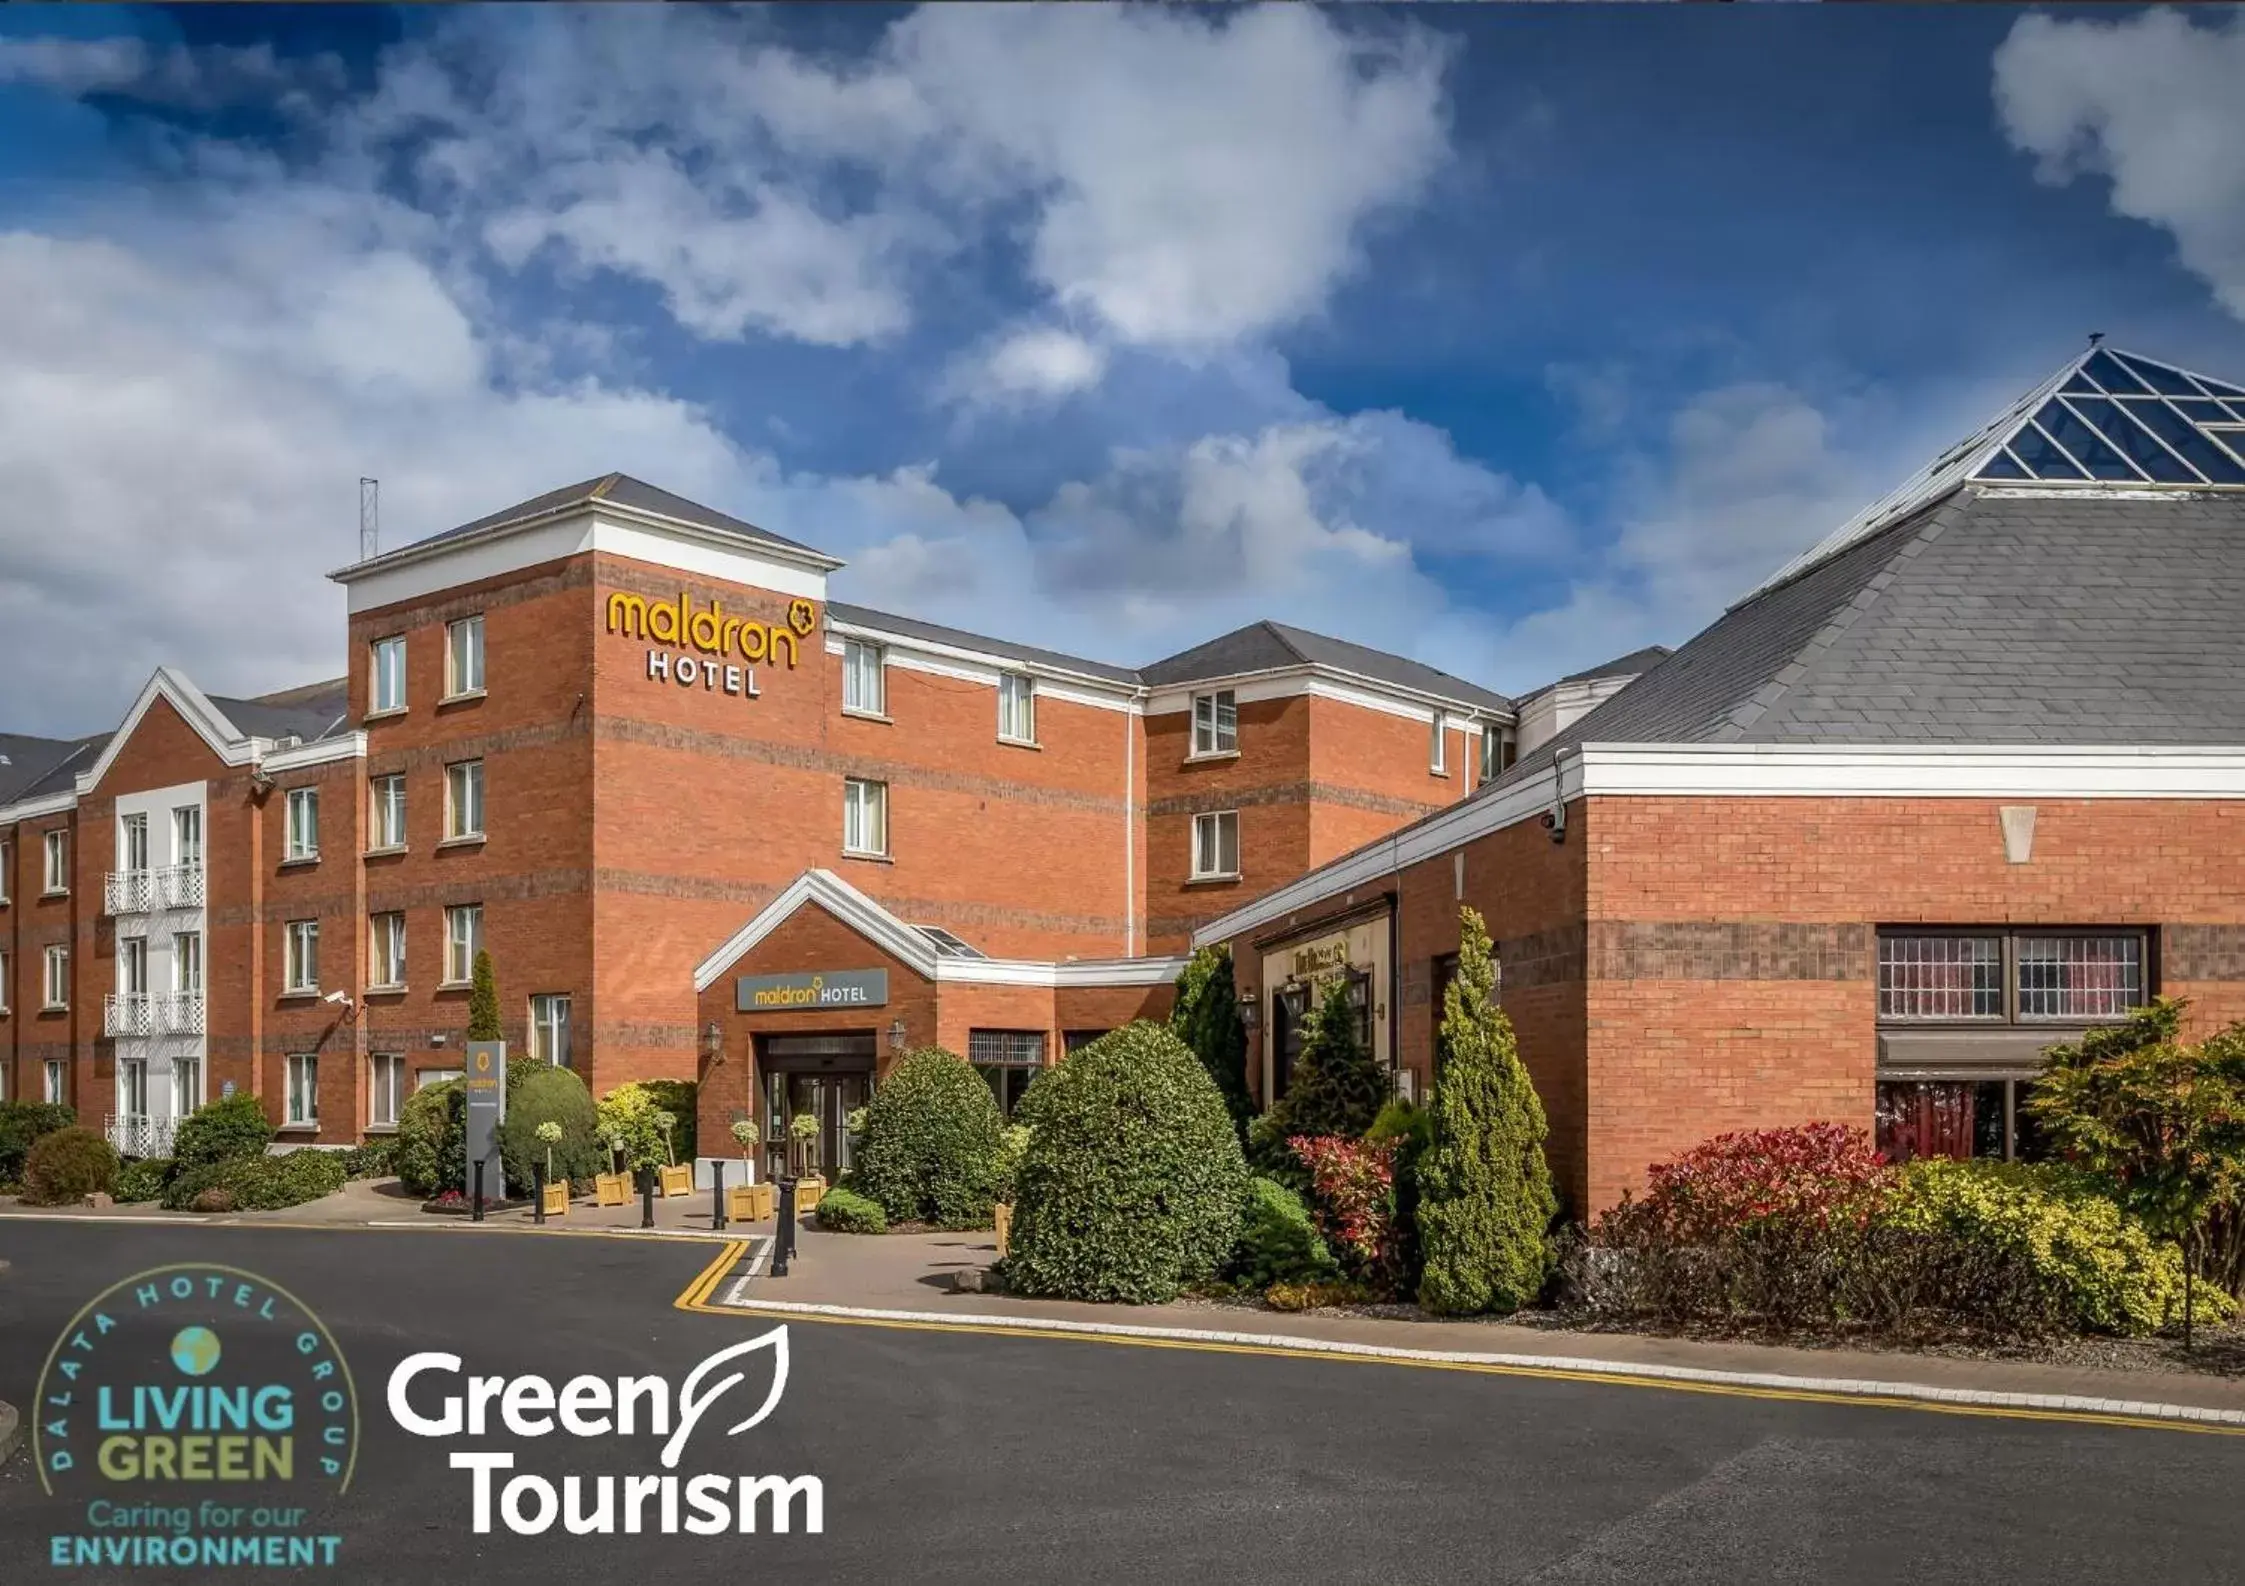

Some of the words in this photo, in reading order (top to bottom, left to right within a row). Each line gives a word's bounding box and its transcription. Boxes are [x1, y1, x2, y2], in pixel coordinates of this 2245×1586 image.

[606, 592, 797, 668] maldron
[647, 650, 761, 698] HOTEL
[755, 984, 816, 1006] maldron
[821, 987, 867, 1003] HOTEL
